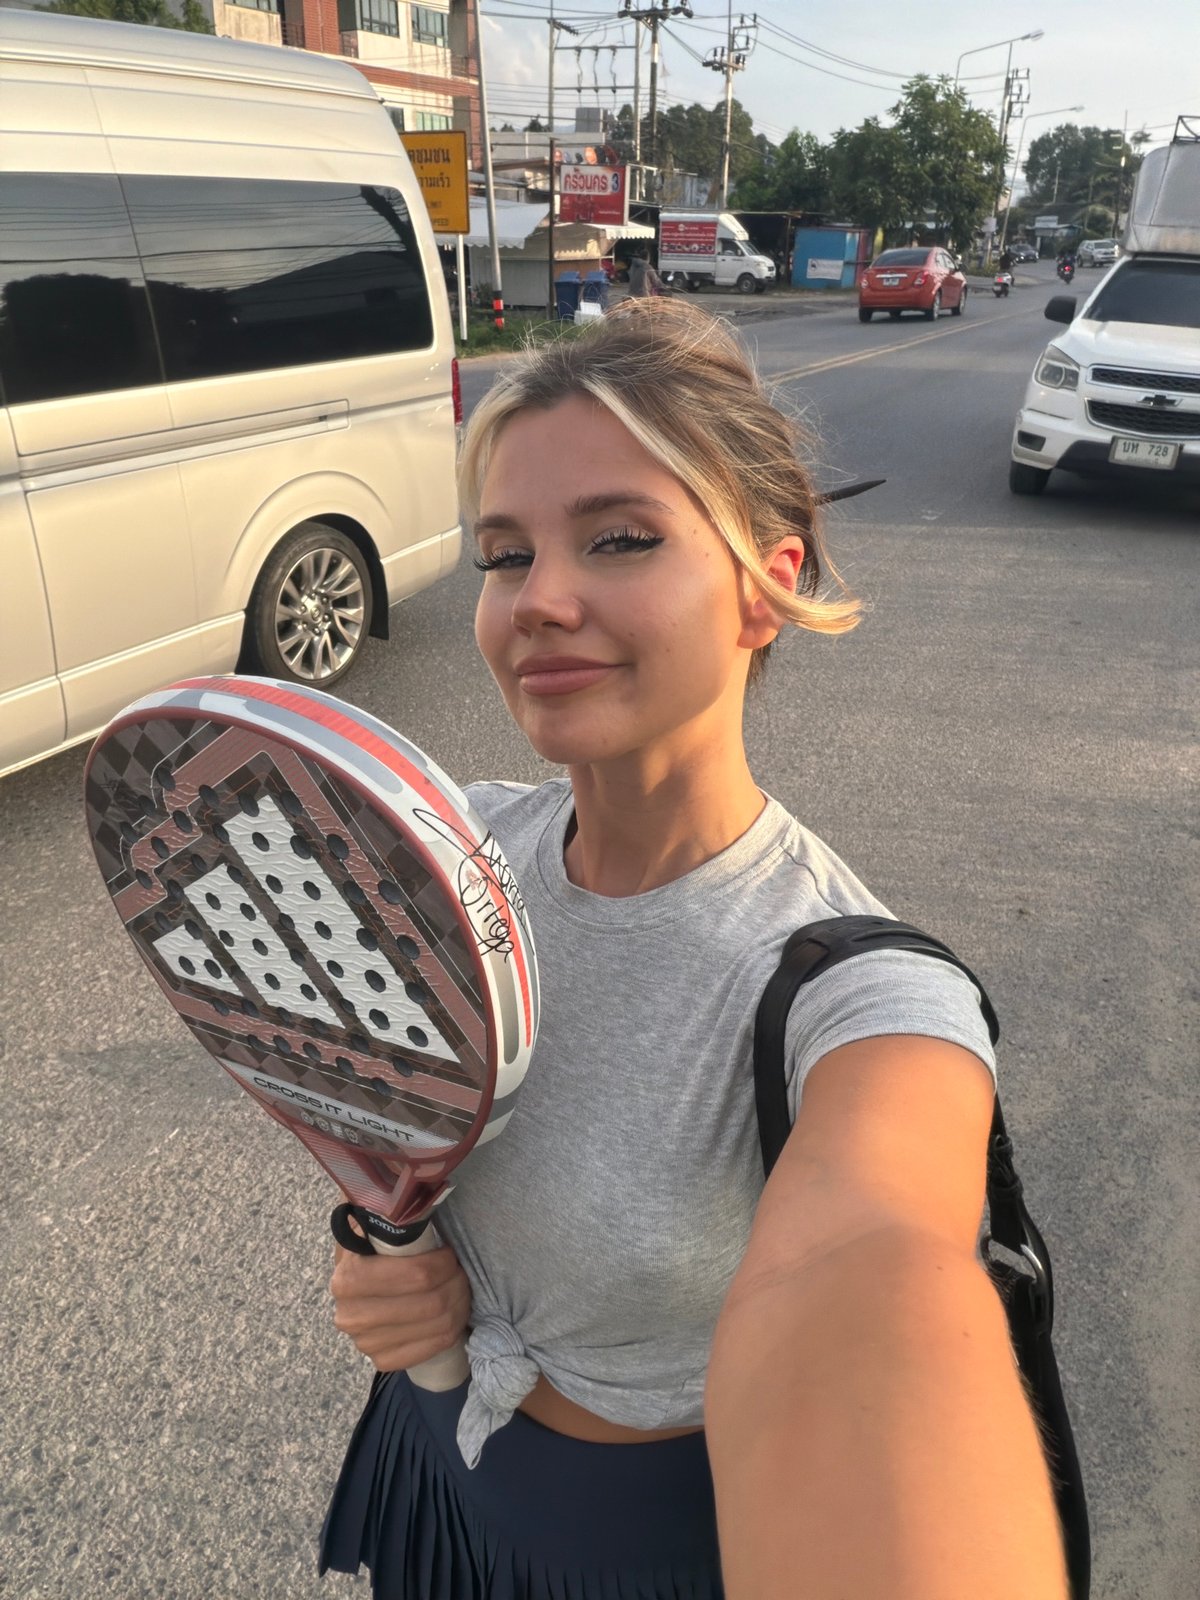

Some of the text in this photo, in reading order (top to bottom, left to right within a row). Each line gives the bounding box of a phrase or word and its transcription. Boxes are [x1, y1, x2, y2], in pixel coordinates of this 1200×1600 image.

[611, 172, 620, 192] 3
[1148, 444, 1169, 457] 728
[253, 1076, 414, 1142] CROSS IT LIGHT
